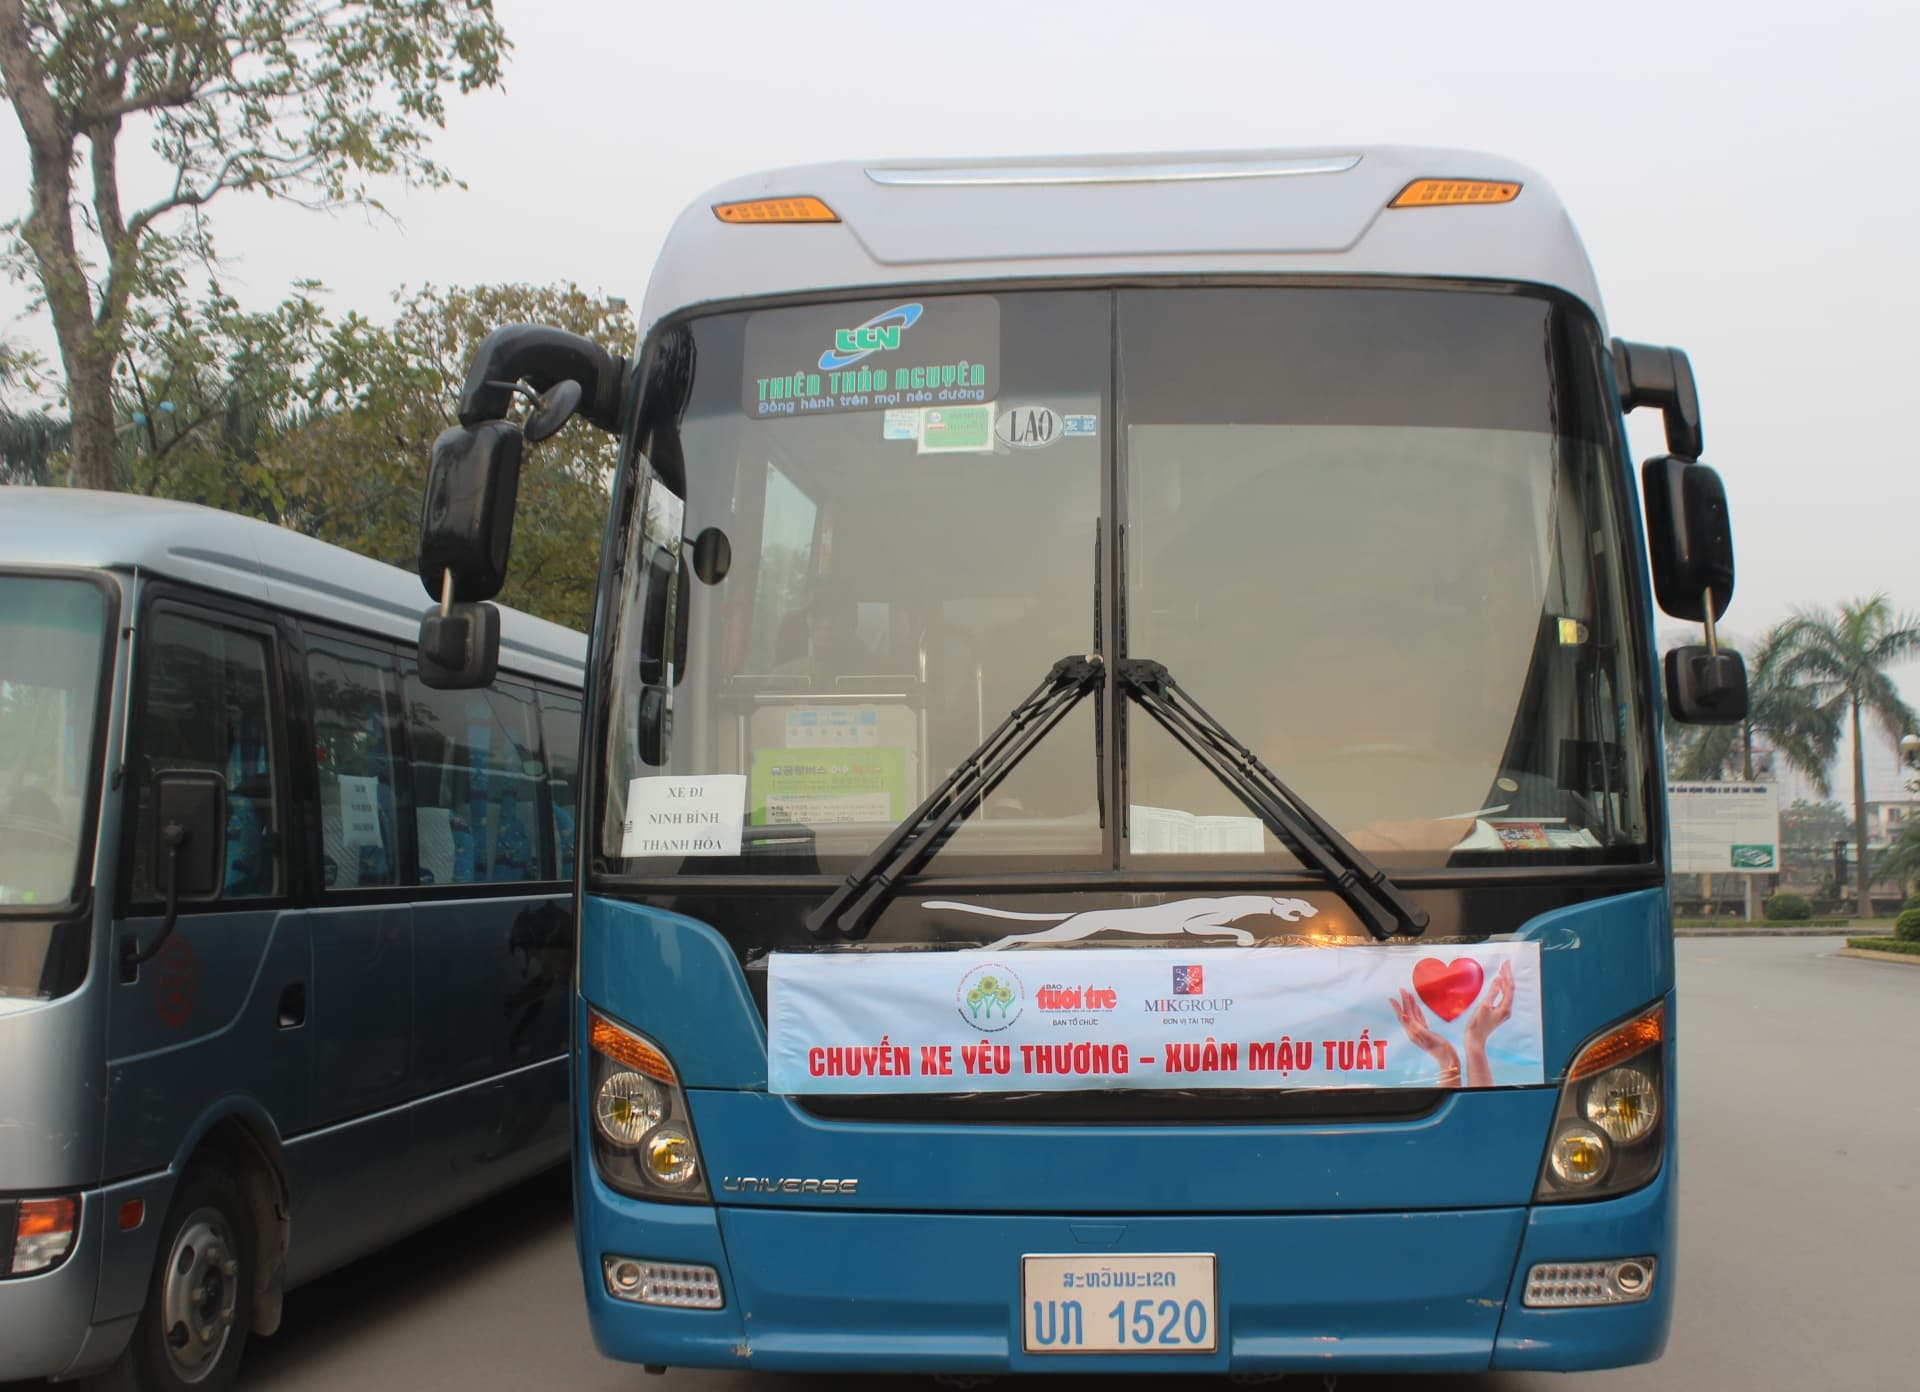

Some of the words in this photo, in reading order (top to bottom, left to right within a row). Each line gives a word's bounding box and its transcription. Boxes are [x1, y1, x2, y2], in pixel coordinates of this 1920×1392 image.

[1010, 409, 1053, 442] LAO
[667, 787, 686, 798] XE
[689, 787, 704, 798] ĐI
[649, 812, 682, 825] NINH
[686, 809, 720, 824] BÌNH
[642, 839, 689, 851] THANH
[1144, 998, 1233, 1012] MIKGROUP
[1052, 1018, 1067, 1026] BAN
[808, 1035, 911, 1077] CHUYẾN
[920, 1045, 953, 1076] XE
[960, 1038, 1011, 1075] YÊU
[1020, 1041, 1130, 1075] THƯƠNG
[1165, 1037, 1238, 1073] XUÂN
[1249, 1036, 1313, 1077] MẬU
[1322, 1029, 1388, 1072] TUẤT
[723, 1176, 858, 1193] UNIVERSE
[1108, 1299, 1207, 1345] 1520
